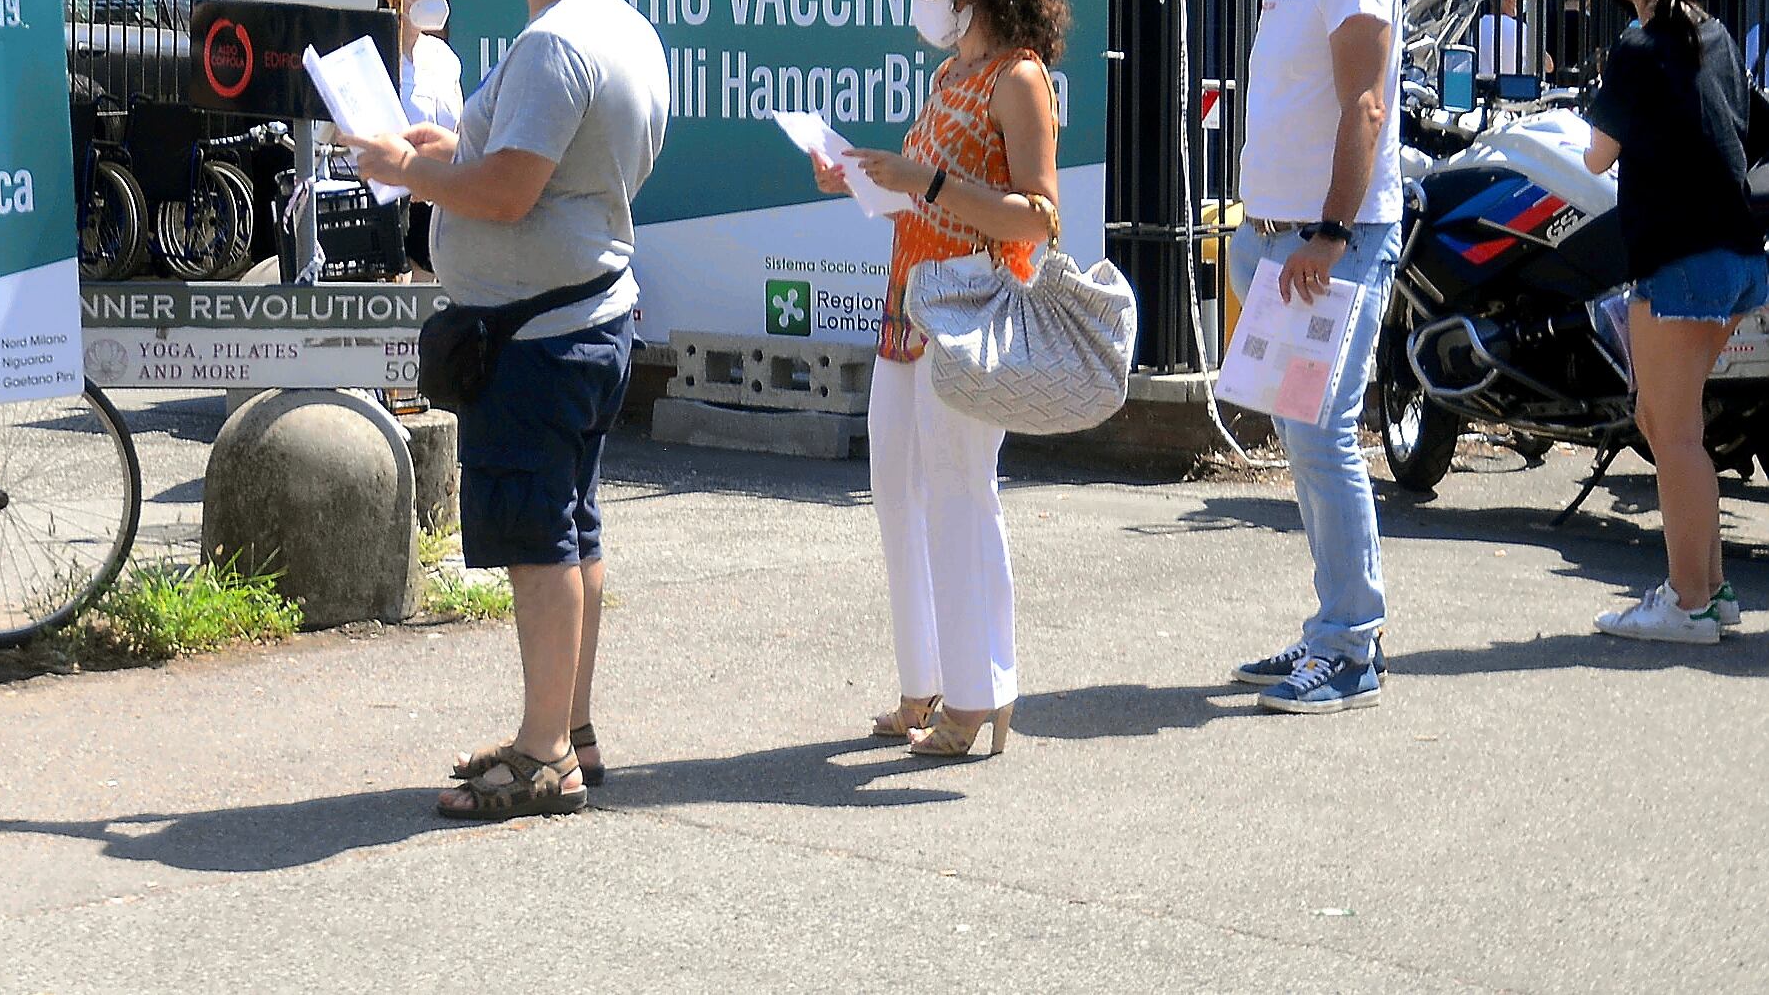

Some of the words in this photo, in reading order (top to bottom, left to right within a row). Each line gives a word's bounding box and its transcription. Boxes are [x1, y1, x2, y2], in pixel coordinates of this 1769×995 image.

[765, 255, 816, 273] Sistema
[820, 259, 857, 275] Socio
[80, 294, 176, 320] NNER
[190, 294, 418, 321] REVOLUTION
[817, 290, 885, 314] Region
[1, 338, 28, 350] Nord
[30, 333, 68, 346] Milano
[138, 342, 204, 361] YOGA,
[212, 342, 299, 359] PILATES
[2, 353, 54, 370] Niguarda
[3, 374, 54, 389] Gaetano
[56, 370, 76, 382] Pini
[138, 363, 182, 381] AND
[191, 364, 251, 381] MORE
